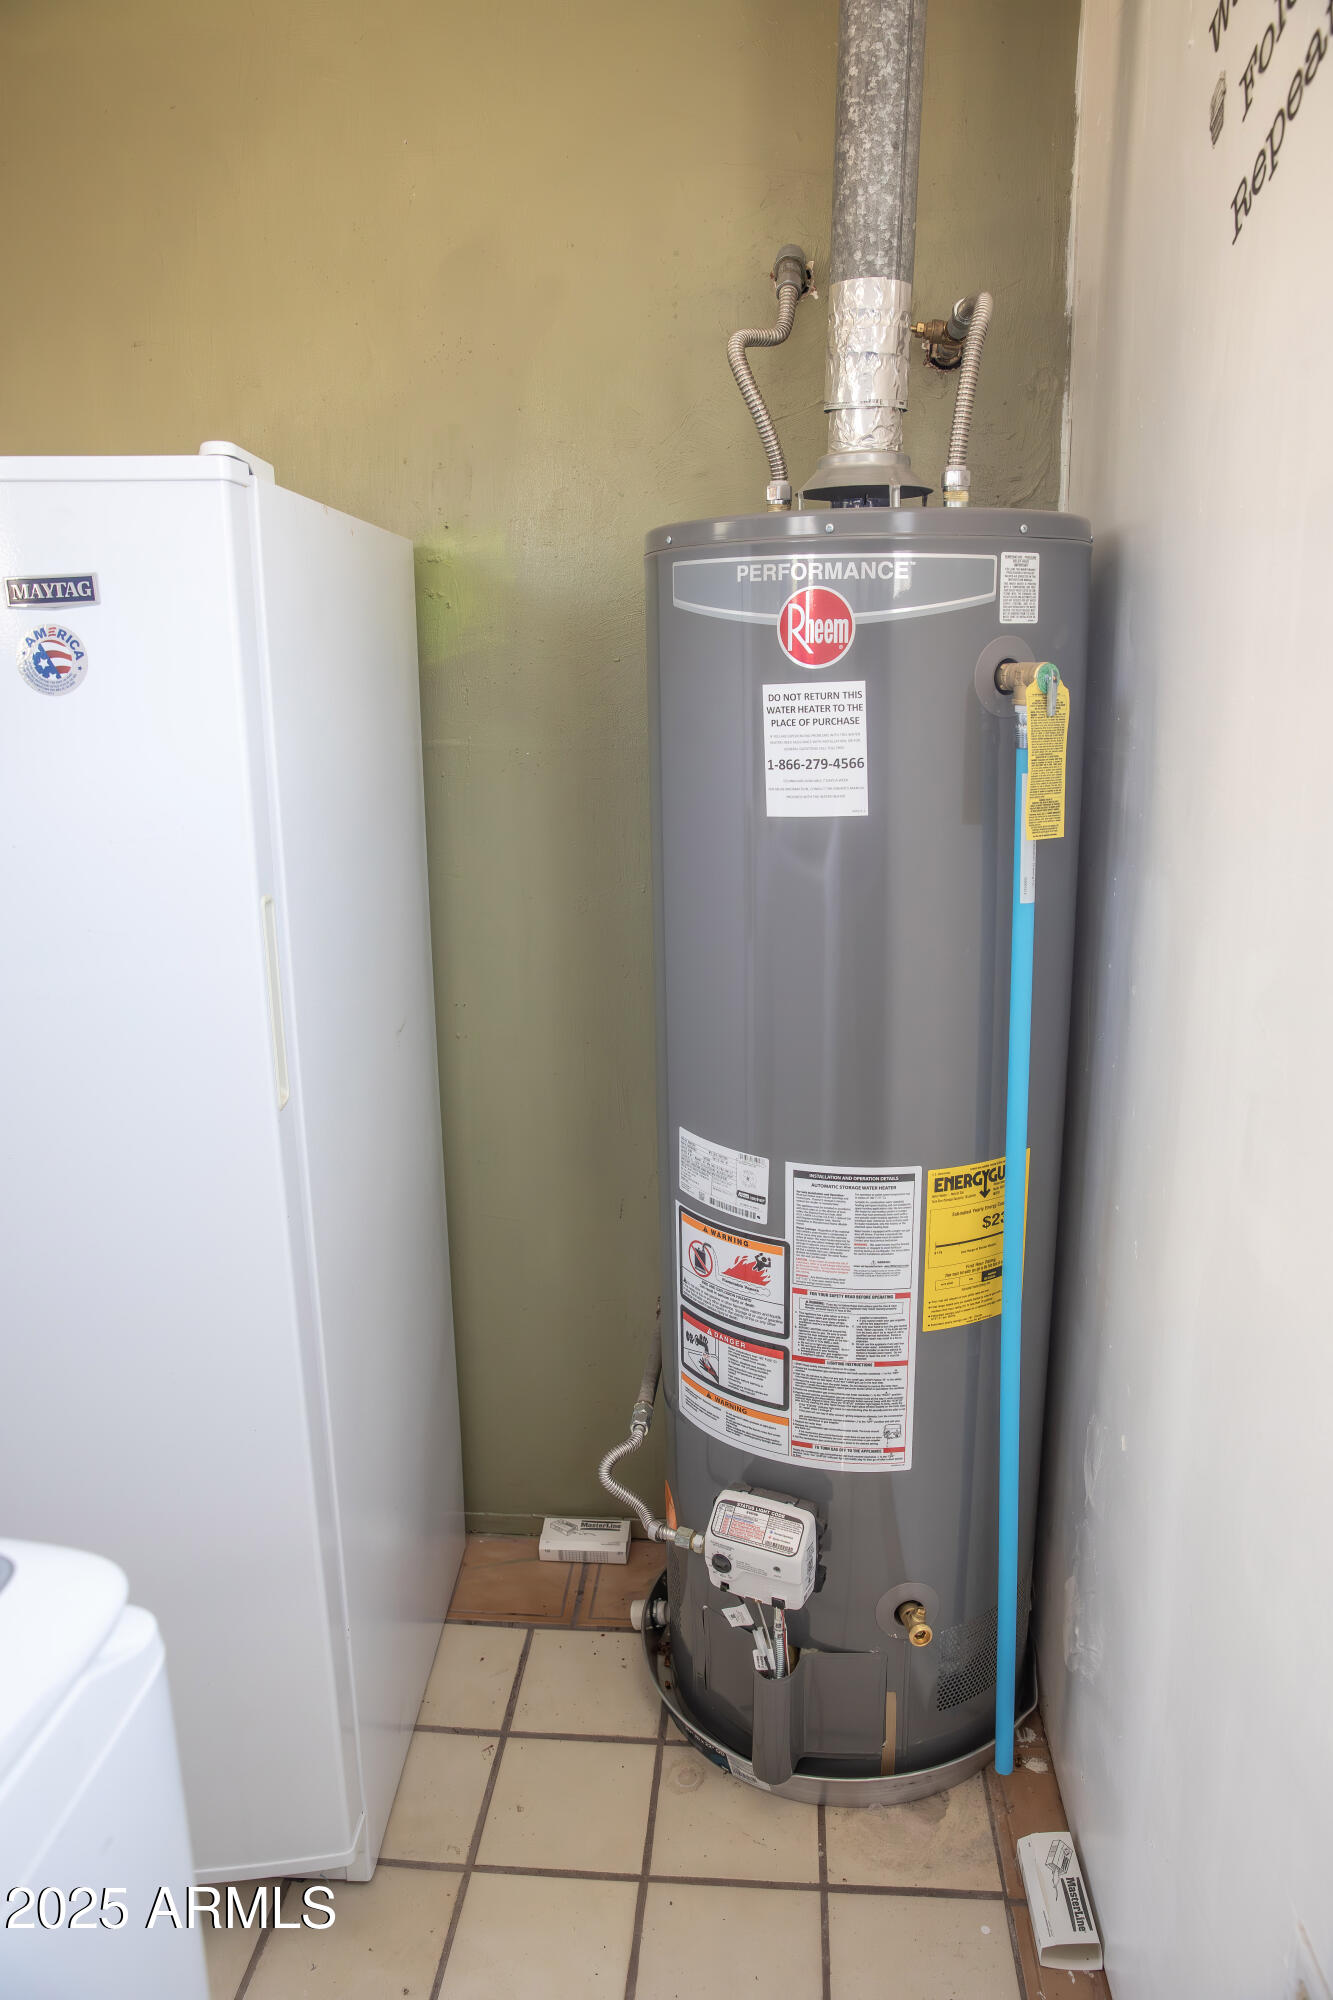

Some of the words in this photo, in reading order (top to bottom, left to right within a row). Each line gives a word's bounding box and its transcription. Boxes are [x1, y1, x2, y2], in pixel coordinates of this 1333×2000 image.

[1239, 0, 1297, 122] Fol
[11, 581, 92, 600] MAYTAG
[787, 591, 849, 655] Rheem
[25, 626, 85, 661] AMERICA
[768, 693, 781, 702] DO
[783, 692, 801, 702] NOT
[804, 691, 840, 701] RETURN
[843, 690, 863, 700] THIS
[766, 705, 796, 715] WATER
[797, 704, 831, 714] HEATER
[832, 703, 845, 712] TO
[847, 703, 864, 712] THE
[771, 718, 797, 727] PLACE
[798, 718, 811, 727] OF
[812, 716, 860, 726] PURCHASE
[767, 757, 865, 770] 1-866-279-4566
[934, 1165, 1006, 1197] ENERGYGU
[710, 1229, 749, 1248] WARNING
[714, 1332, 746, 1349] DANGER
[714, 1396, 748, 1415] WARNING
[1065, 1876, 1087, 1932] MasterLine
